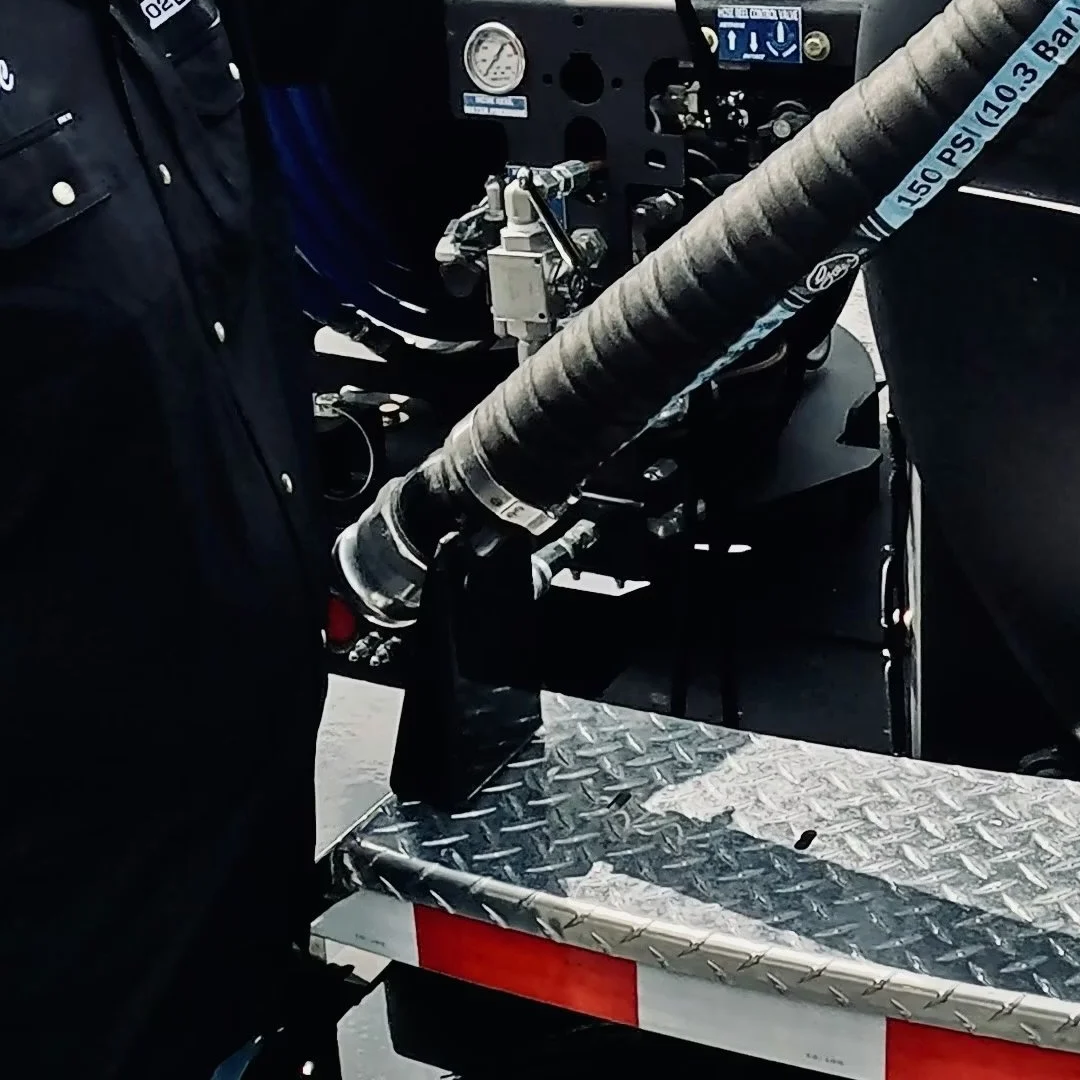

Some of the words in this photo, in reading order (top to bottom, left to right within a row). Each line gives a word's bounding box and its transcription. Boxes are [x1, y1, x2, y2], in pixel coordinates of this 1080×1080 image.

[897, 166, 943, 209] 150
[936, 126, 983, 167] PSI
[974, 62, 1038, 128] (10.3
